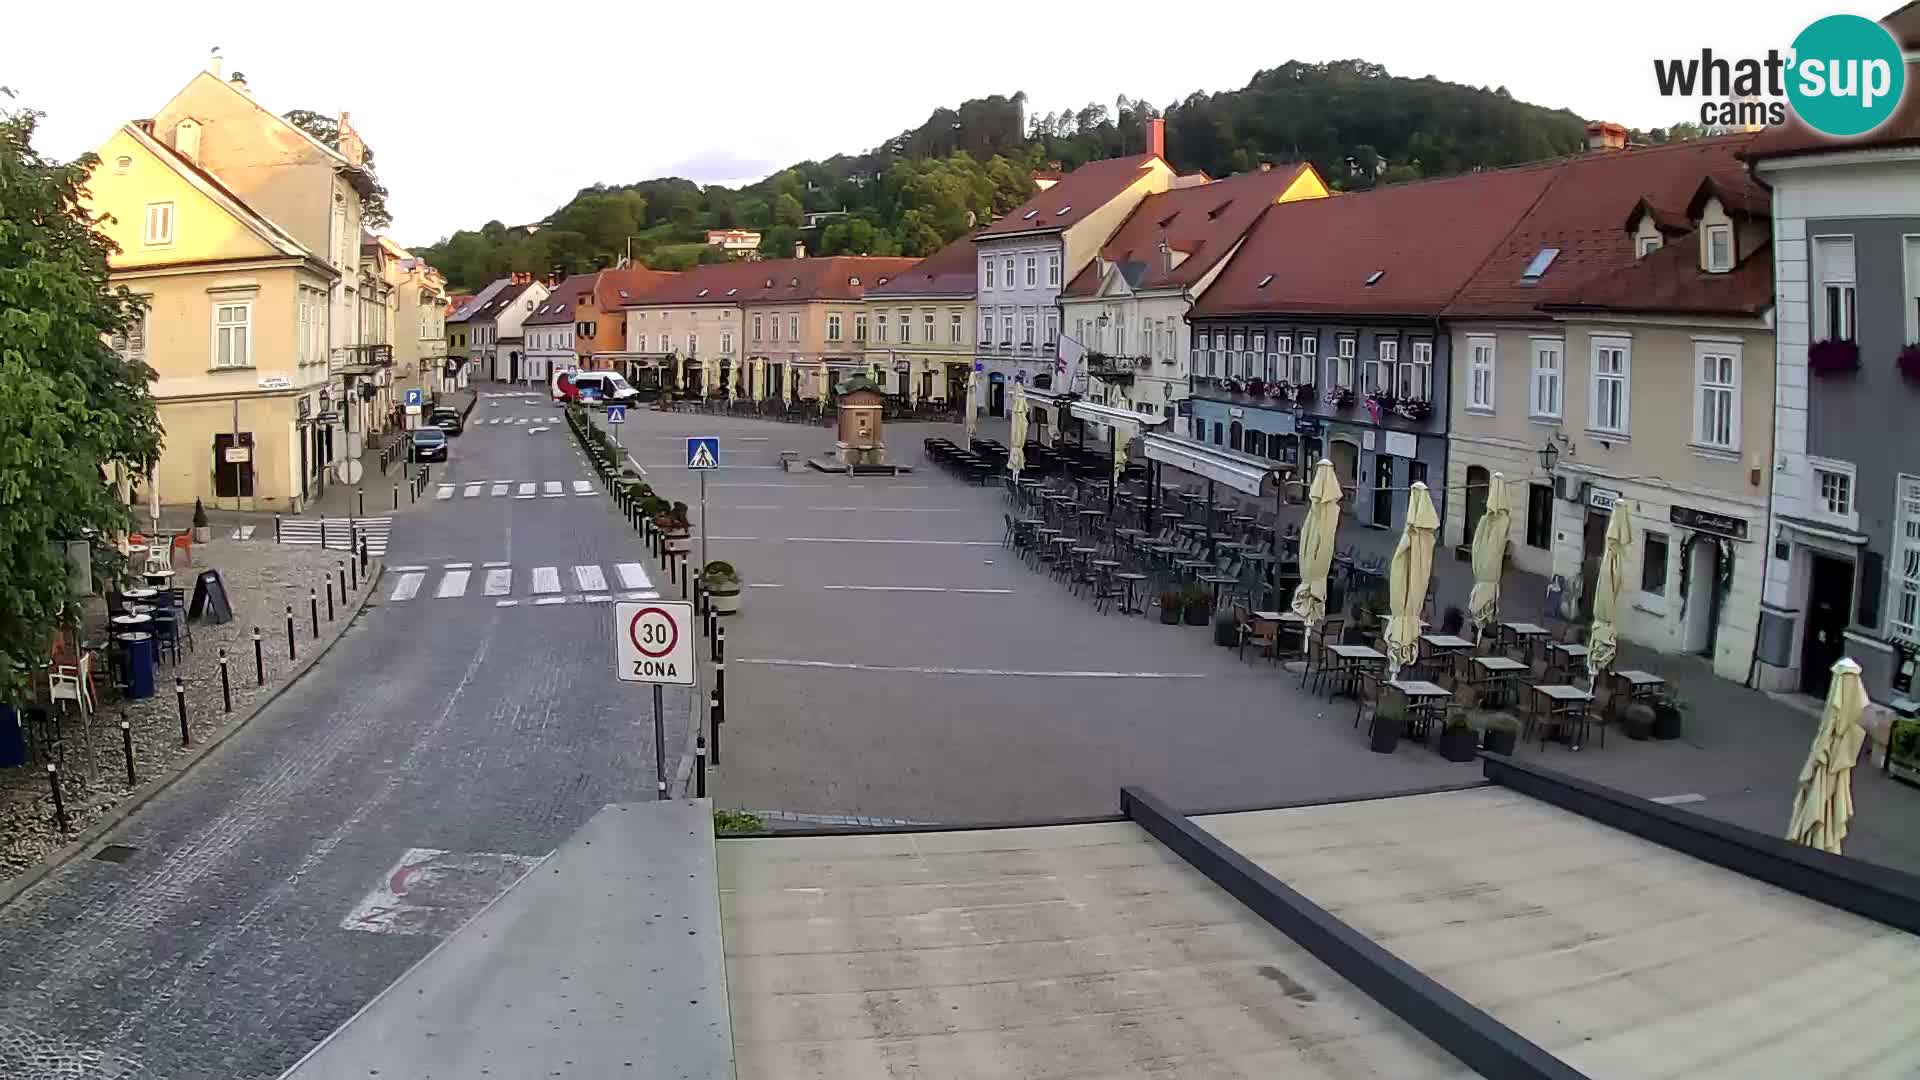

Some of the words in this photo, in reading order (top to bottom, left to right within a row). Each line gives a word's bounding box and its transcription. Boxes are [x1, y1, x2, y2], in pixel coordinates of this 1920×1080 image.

[409, 392, 418, 403] P
[642, 623, 667, 644] 30
[633, 660, 677, 677] ZONA
